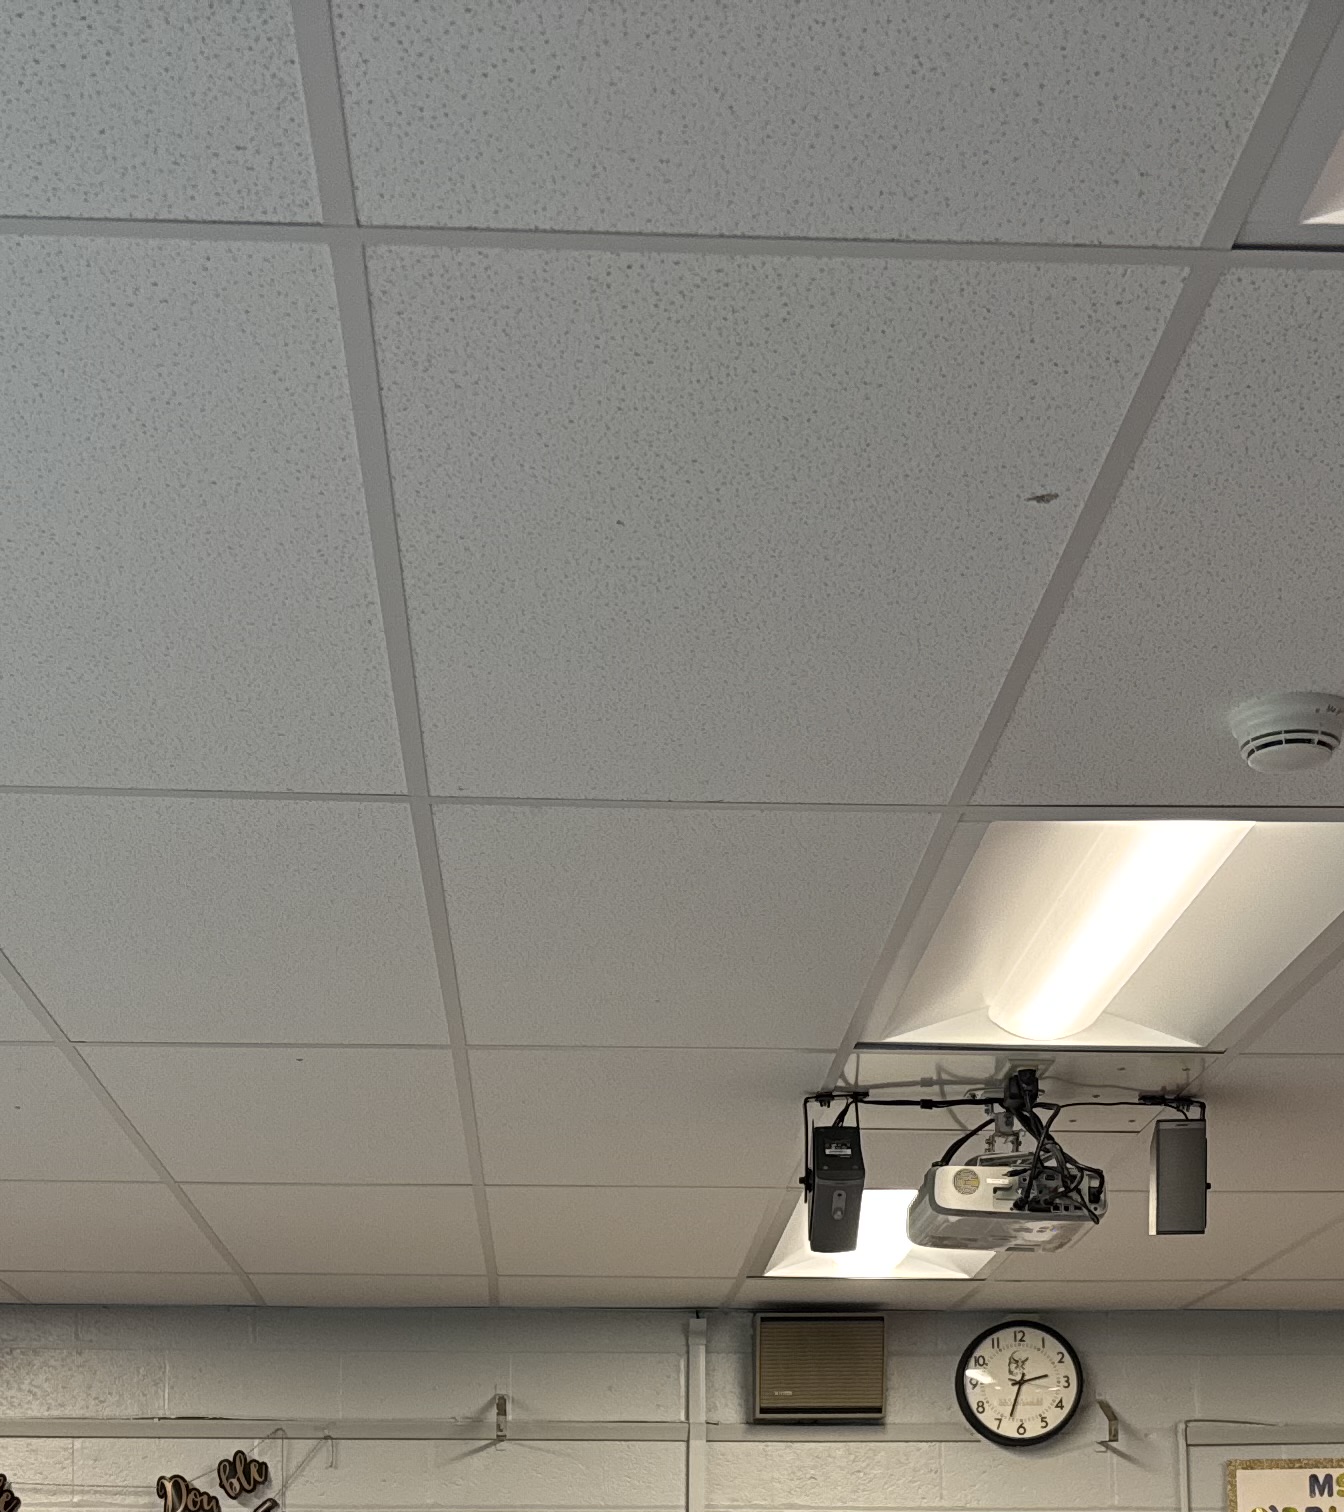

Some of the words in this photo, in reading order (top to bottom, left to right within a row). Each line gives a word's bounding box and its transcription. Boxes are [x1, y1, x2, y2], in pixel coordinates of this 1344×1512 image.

[992, 1337, 1000, 1349] 11
[1014, 1330, 1026, 1343] 12
[974, 1355, 986, 1367] 10
[1056, 1351, 1065, 1364] 2
[969, 1378, 979, 1390] 9
[1062, 1375, 1071, 1389] 3
[976, 1400, 986, 1414] 8
[1054, 1397, 1065, 1411] 4
[994, 1417, 1002, 1430] 7
[1016, 1422, 1027, 1436] 6
[1040, 1416, 1049, 1429] 5
